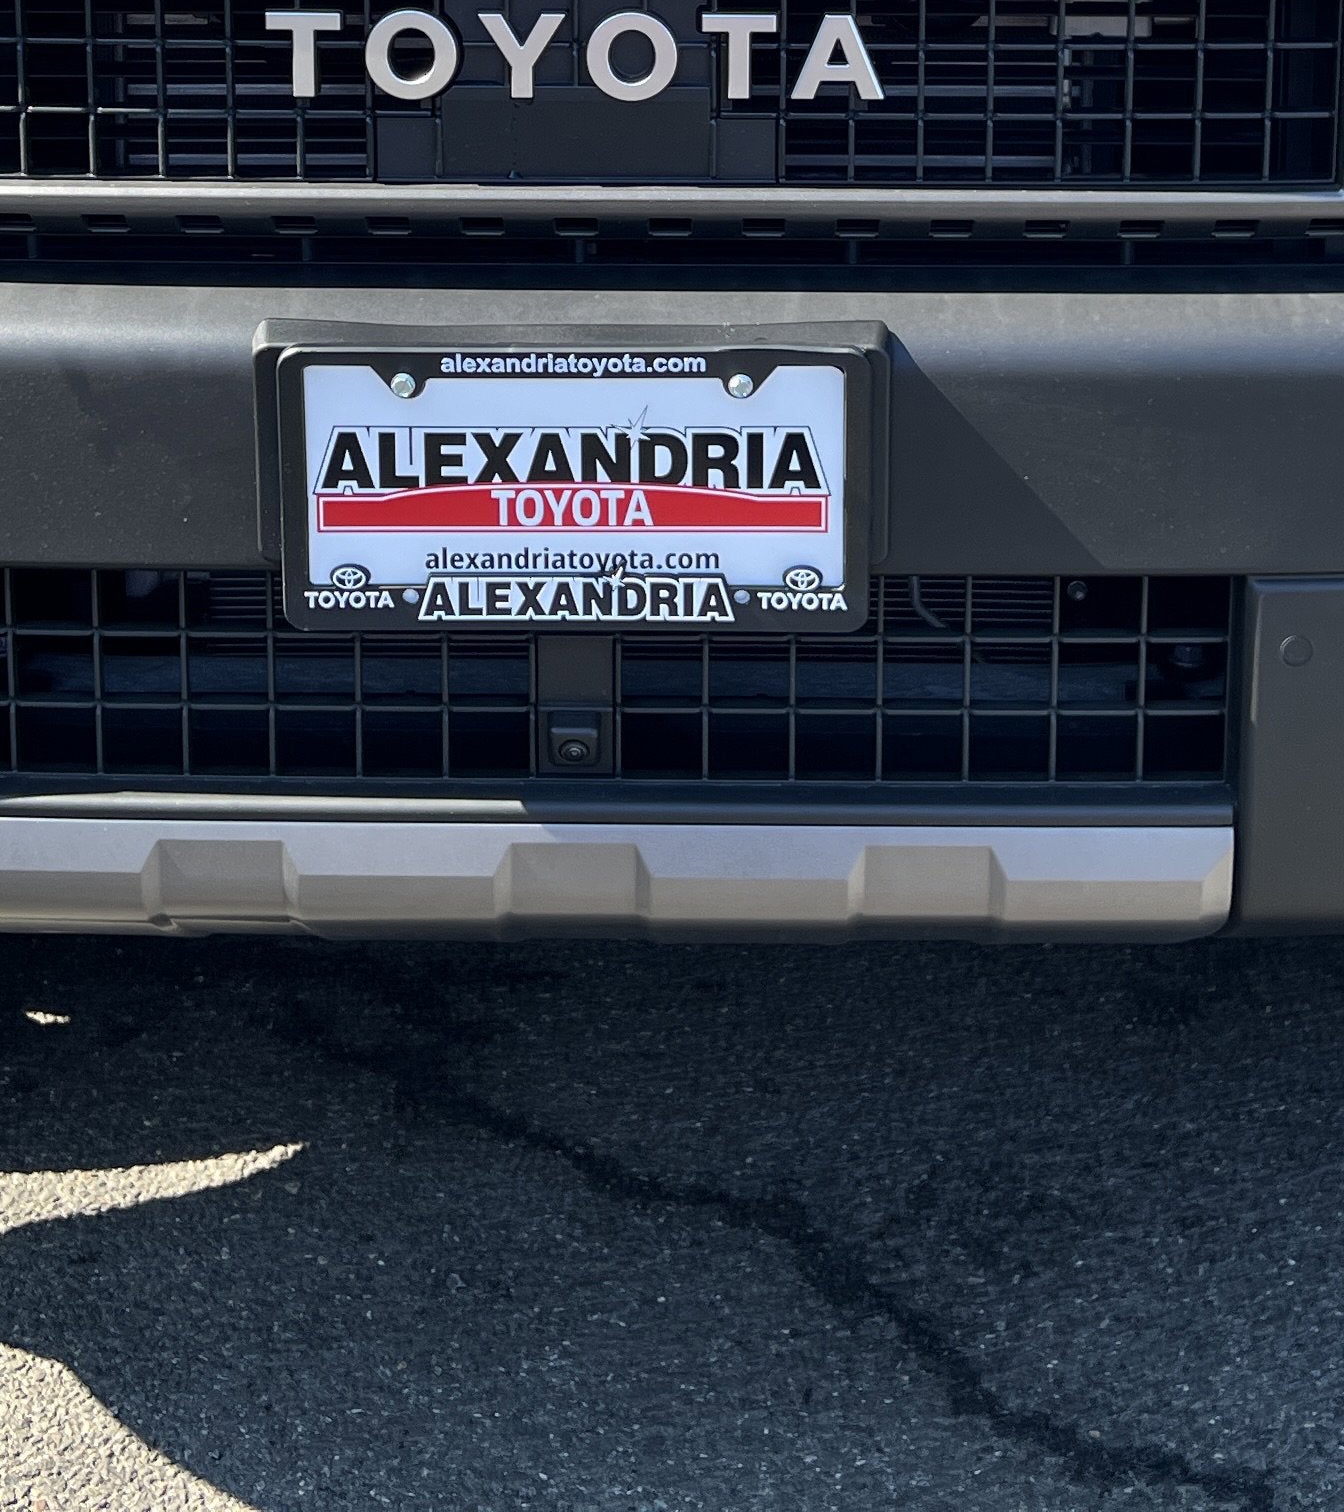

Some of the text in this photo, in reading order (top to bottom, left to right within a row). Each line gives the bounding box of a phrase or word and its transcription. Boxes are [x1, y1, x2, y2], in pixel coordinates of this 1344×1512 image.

[264, 7, 886, 102] TOYOTA
[440, 352, 707, 378] alexandriatoyota.com
[316, 428, 827, 491] ALEXANDRIA
[490, 489, 655, 527] TOYOTA
[424, 546, 720, 573] alexandriatoyota.com
[303, 590, 395, 610] TOYOTA
[419, 577, 735, 621] ALEXANDRIA
[756, 591, 848, 612] TOYOTA
